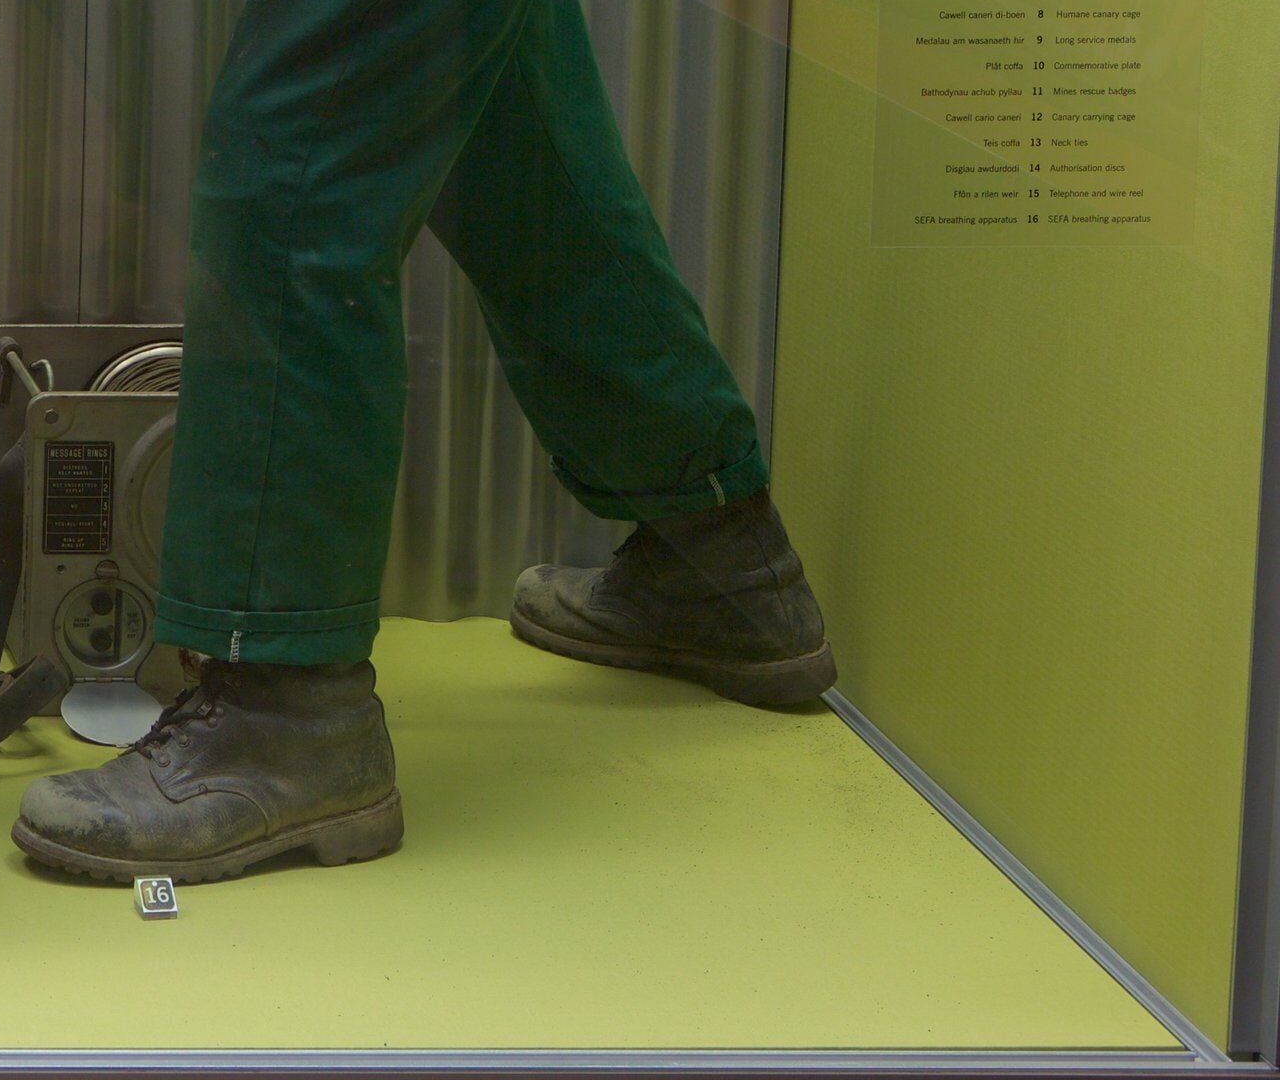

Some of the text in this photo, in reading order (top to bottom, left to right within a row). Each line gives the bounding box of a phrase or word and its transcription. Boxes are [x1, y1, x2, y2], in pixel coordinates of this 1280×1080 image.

[50, 448, 108, 458] MESSAGE RINGS
[145, 886, 170, 904] 16
